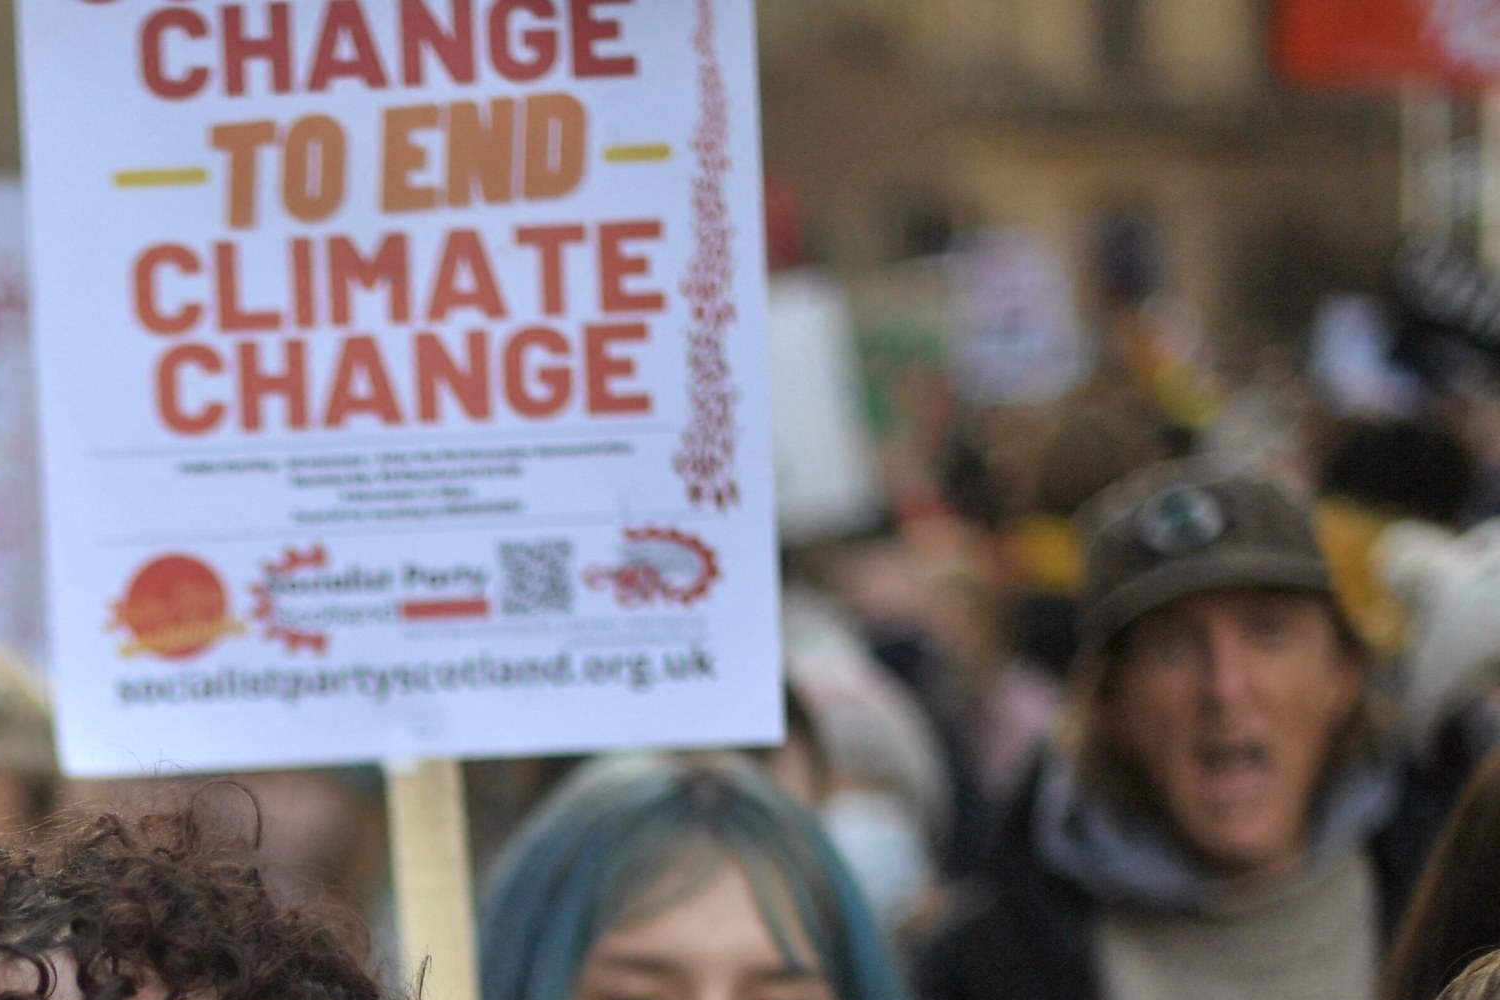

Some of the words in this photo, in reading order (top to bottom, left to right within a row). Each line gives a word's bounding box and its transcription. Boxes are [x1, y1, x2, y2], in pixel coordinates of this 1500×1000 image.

[137, 0, 639, 100] CHANGE
[210, 114, 347, 230] TO
[380, 92, 588, 214] END
[130, 219, 667, 336] CLIMATE
[152, 322, 654, 437] CHANGE
[401, 559, 487, 596] Party
[116, 642, 717, 706] socialistpartyscotland.org.uk
